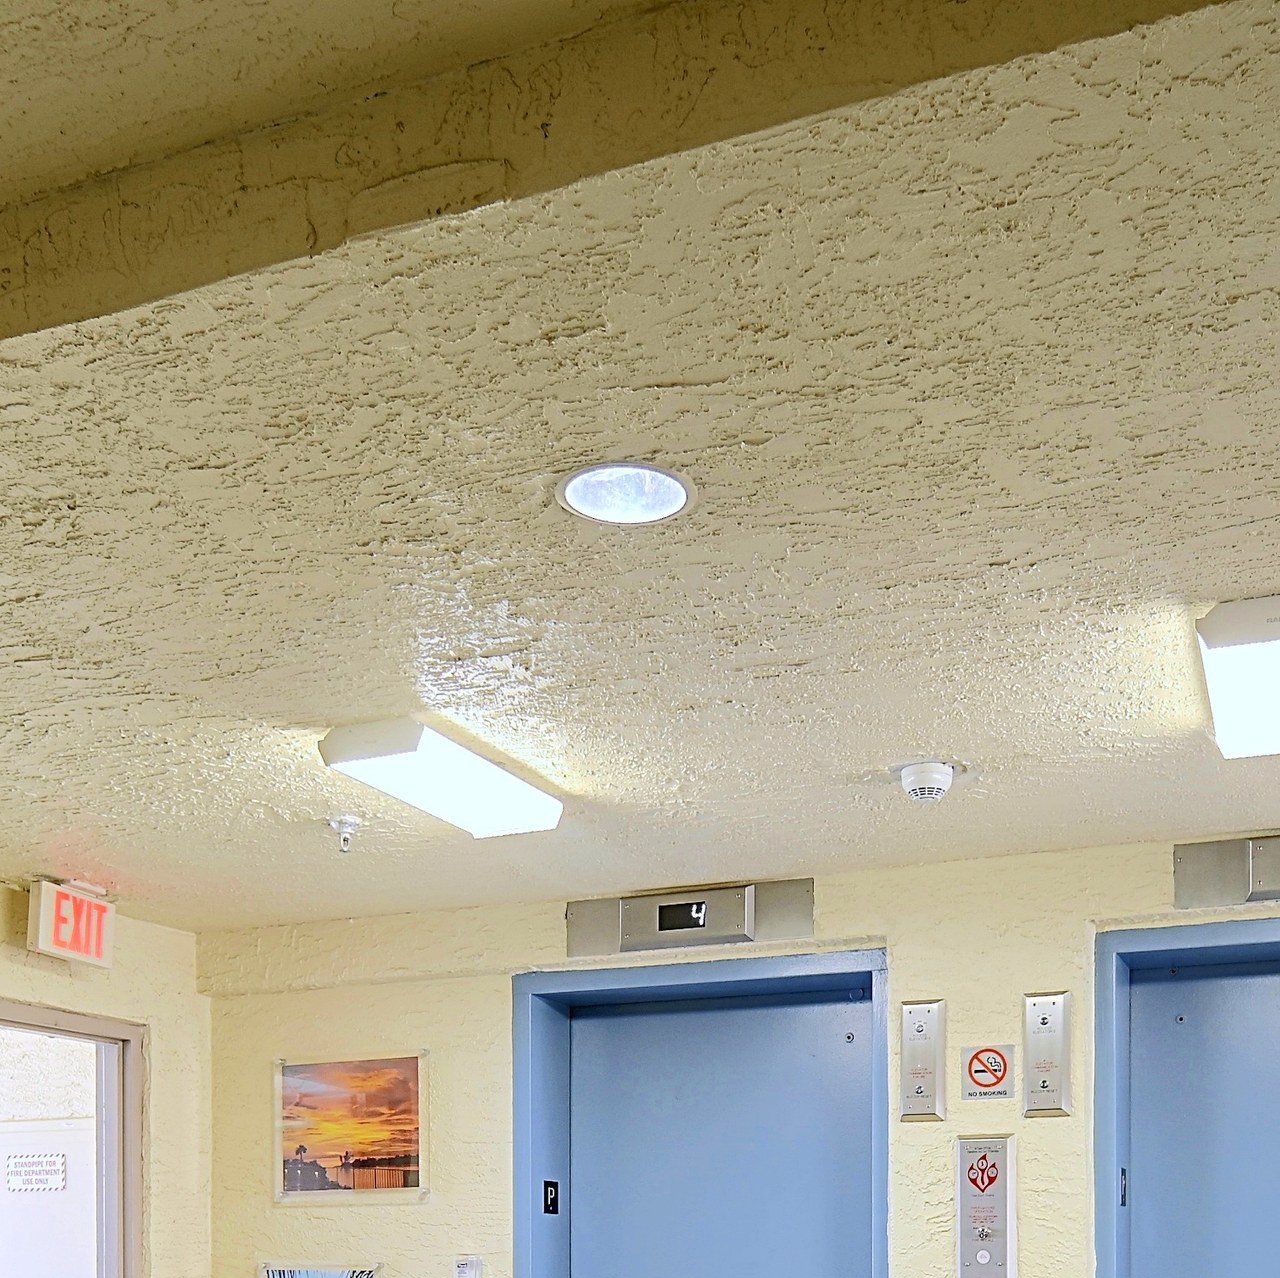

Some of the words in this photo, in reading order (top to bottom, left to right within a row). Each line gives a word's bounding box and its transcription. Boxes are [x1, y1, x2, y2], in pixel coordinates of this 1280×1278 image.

[691, 903, 706, 926] 4
[52, 890, 108, 960] EXIT
[10, 1169, 23, 1177] FIRE
[24, 1168, 60, 1176] DEPARTMENT
[14, 1160, 44, 1168] STANDPIPE
[548, 1187, 555, 1205] P
